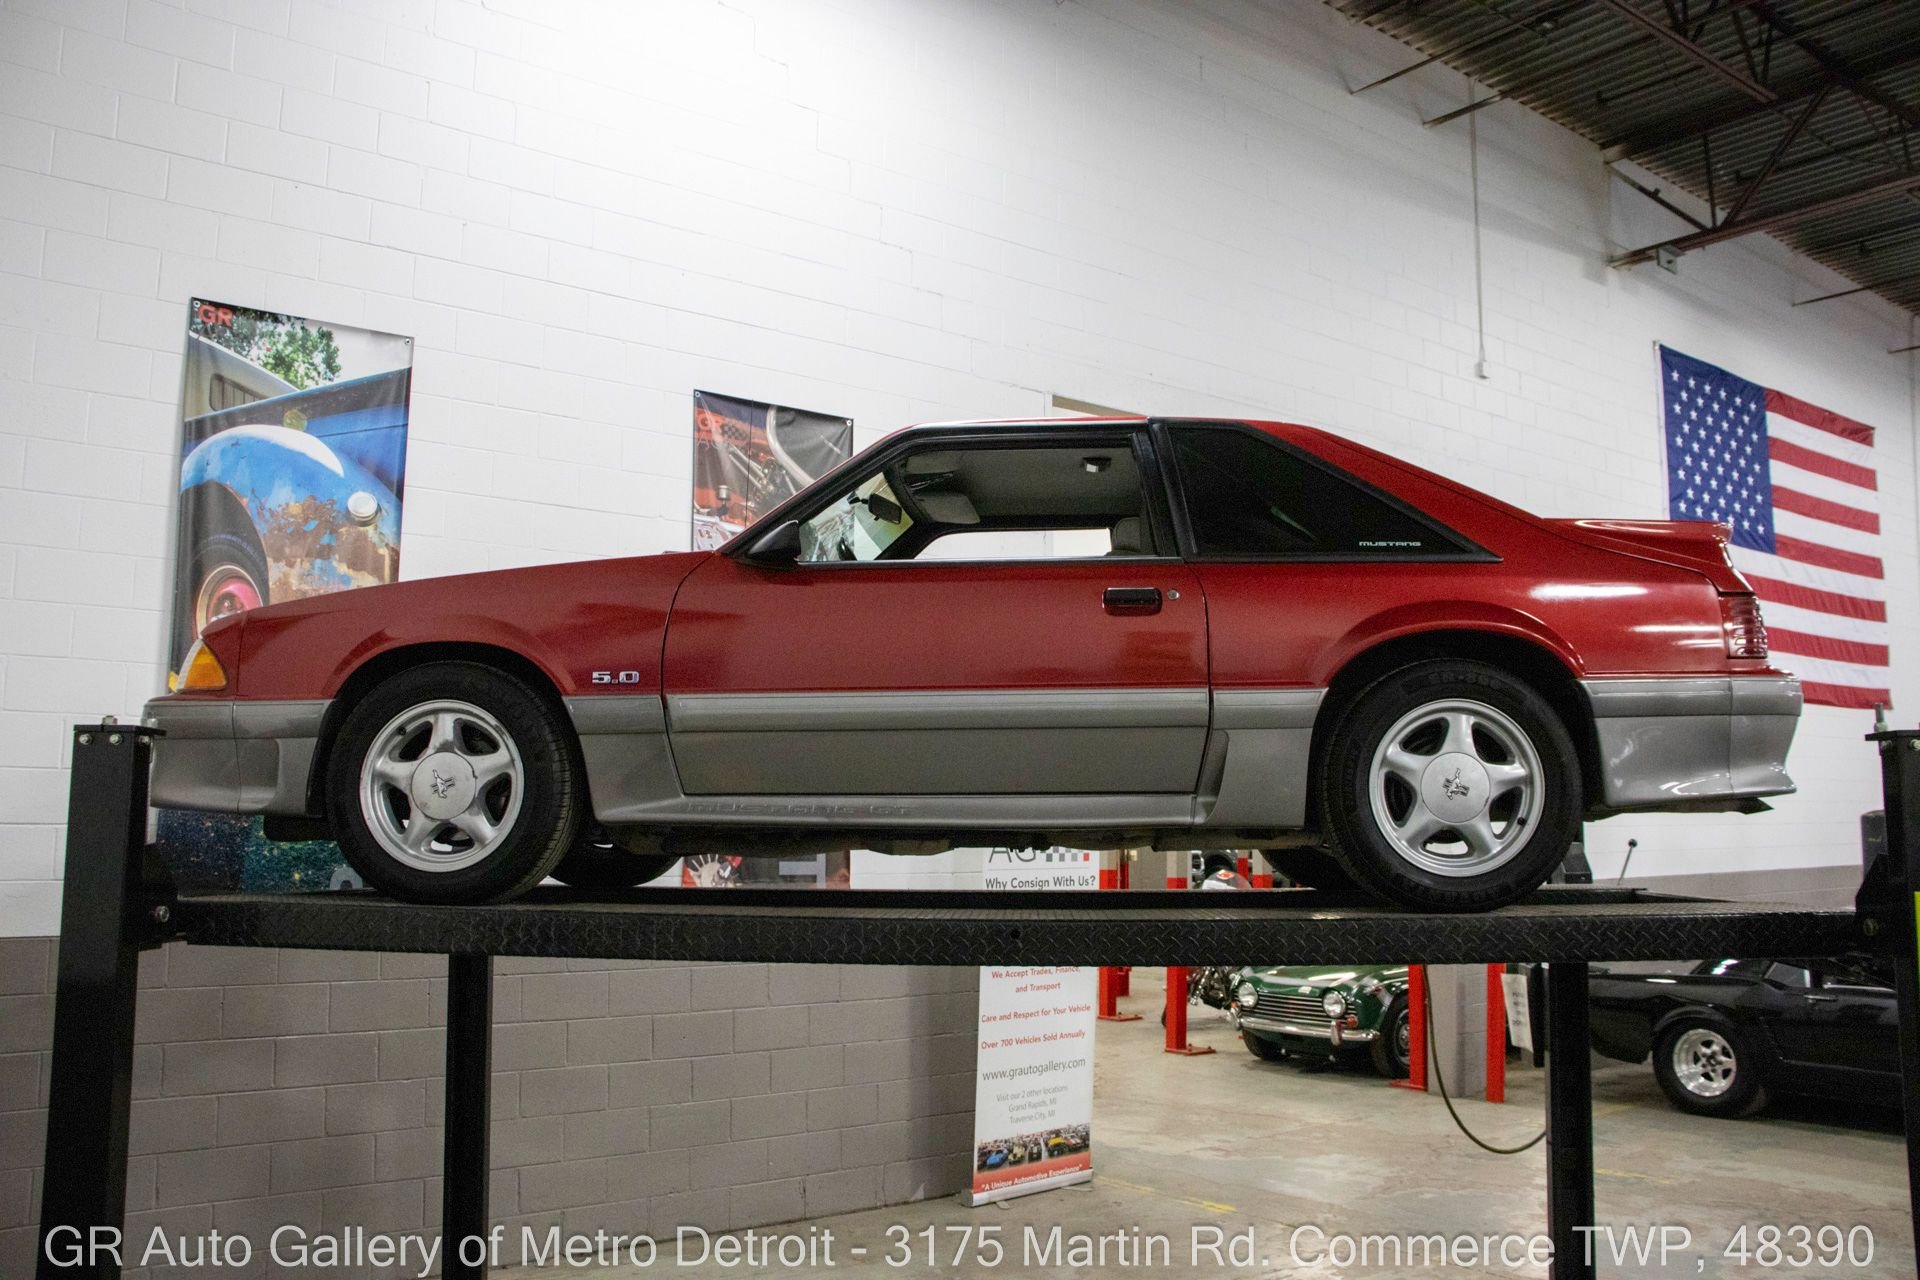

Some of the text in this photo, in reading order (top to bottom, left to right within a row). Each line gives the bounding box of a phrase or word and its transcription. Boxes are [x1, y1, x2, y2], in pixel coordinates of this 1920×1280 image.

[197, 304, 233, 329] GR
[592, 671, 640, 684] 5.0
[985, 875, 1096, 890] Why Consign With Us?
[991, 971, 1003, 979] We
[1005, 969, 1028, 978] Accept
[1015, 982, 1061, 993] and Transport
[981, 1004, 1091, 1023] Care and Respect for Your Vehicle
[981, 1029, 1086, 1050] Over 700 Vehicles Sold Annually
[982, 1058, 1086, 1080] www.grautogallery.com
[1027, 1089, 1042, 1098] other
[1009, 1103, 1027, 1113] Grand
[991, 1179, 1012, 1189] Unique
[1014, 1173, 1048, 1184] Automotive
